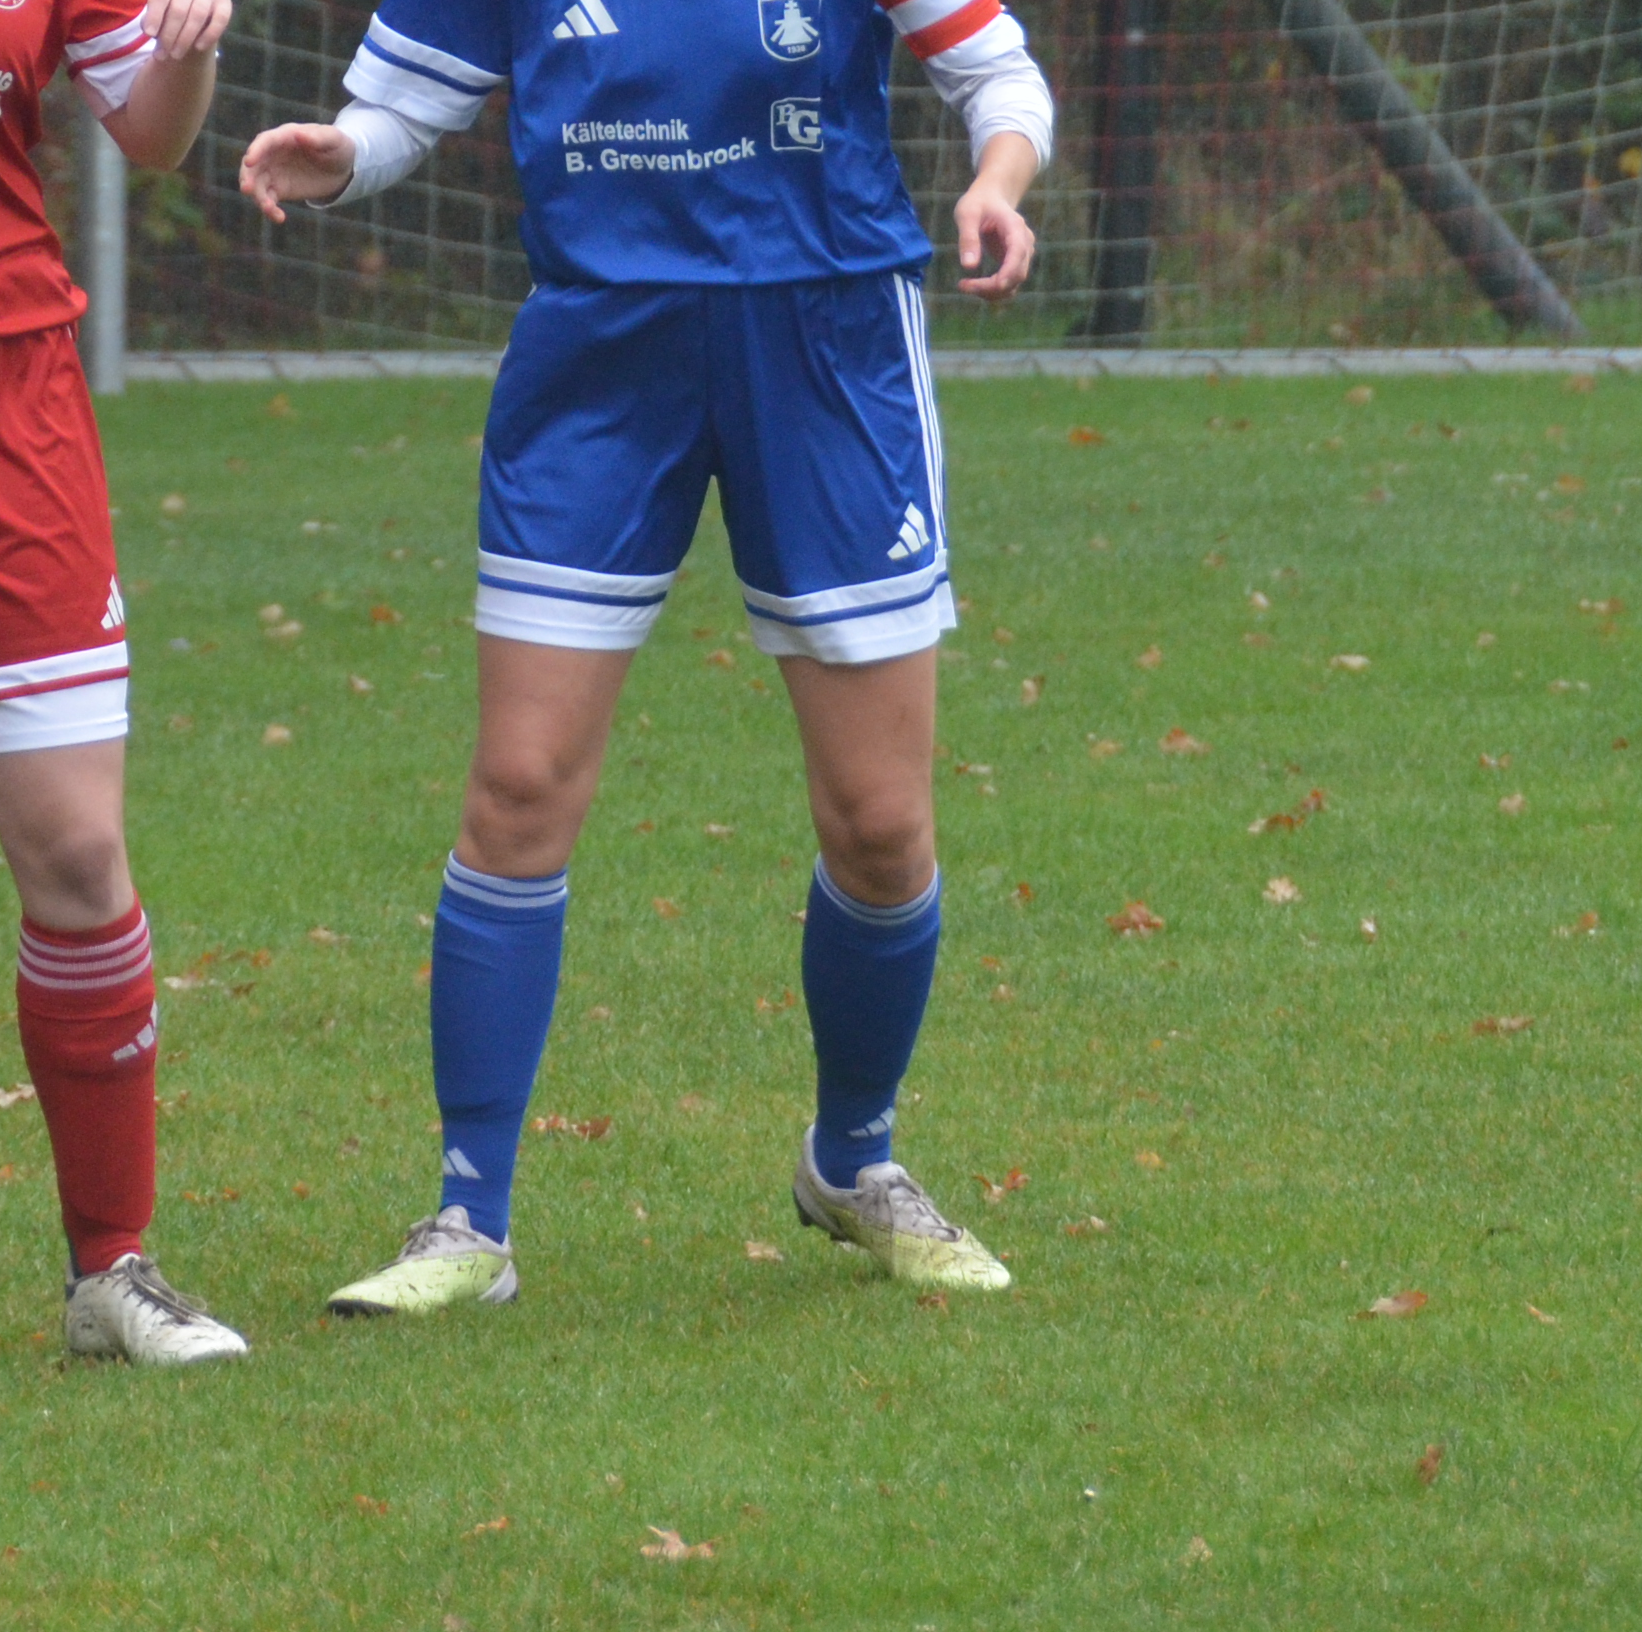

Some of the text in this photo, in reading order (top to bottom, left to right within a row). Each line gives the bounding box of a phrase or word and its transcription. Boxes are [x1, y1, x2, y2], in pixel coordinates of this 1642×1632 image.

[562, 119, 690, 144] Kältetechnik
[565, 137, 756, 172] B. Grevenbrock
